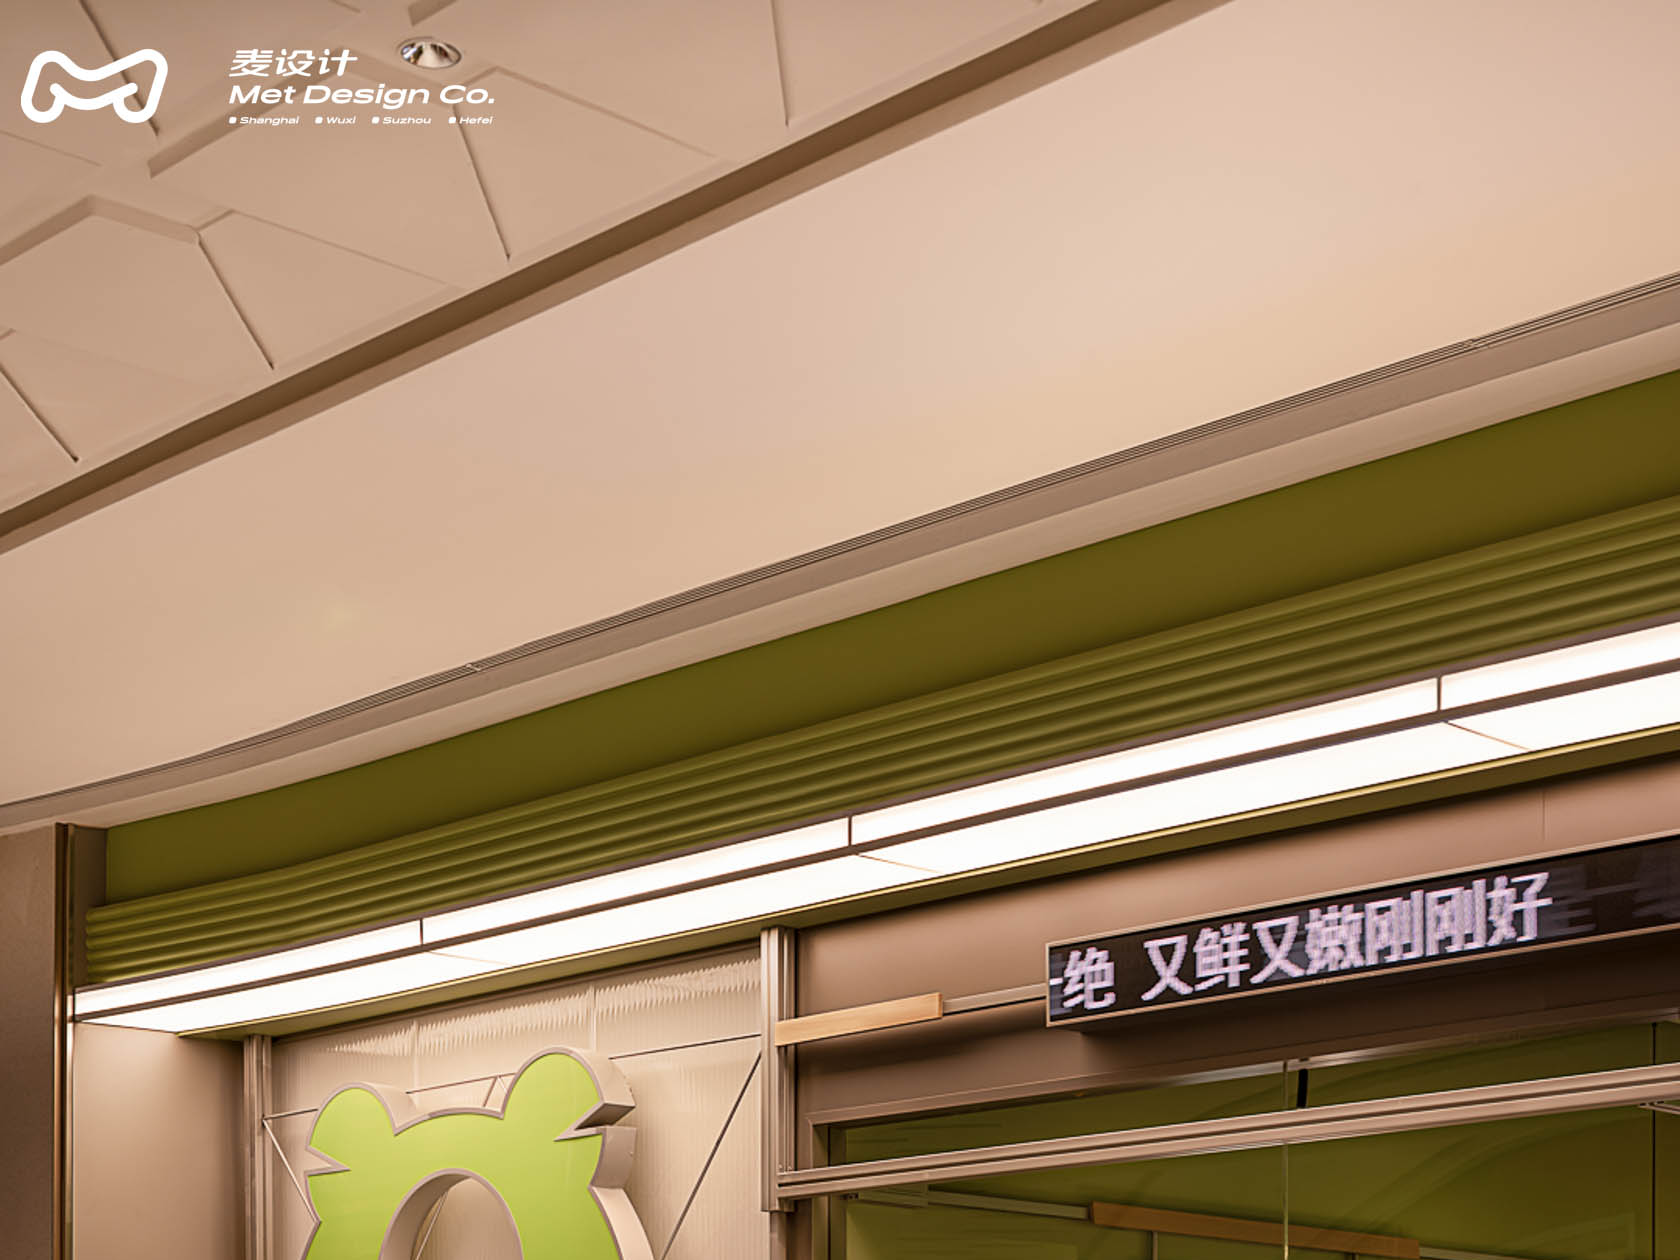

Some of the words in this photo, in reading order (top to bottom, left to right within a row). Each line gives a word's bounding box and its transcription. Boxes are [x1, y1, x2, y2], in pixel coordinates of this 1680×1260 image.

[1049, 946, 1116, 1010] 绝
[1141, 872, 1553, 1001] 又鲜又嫩刚刚好
